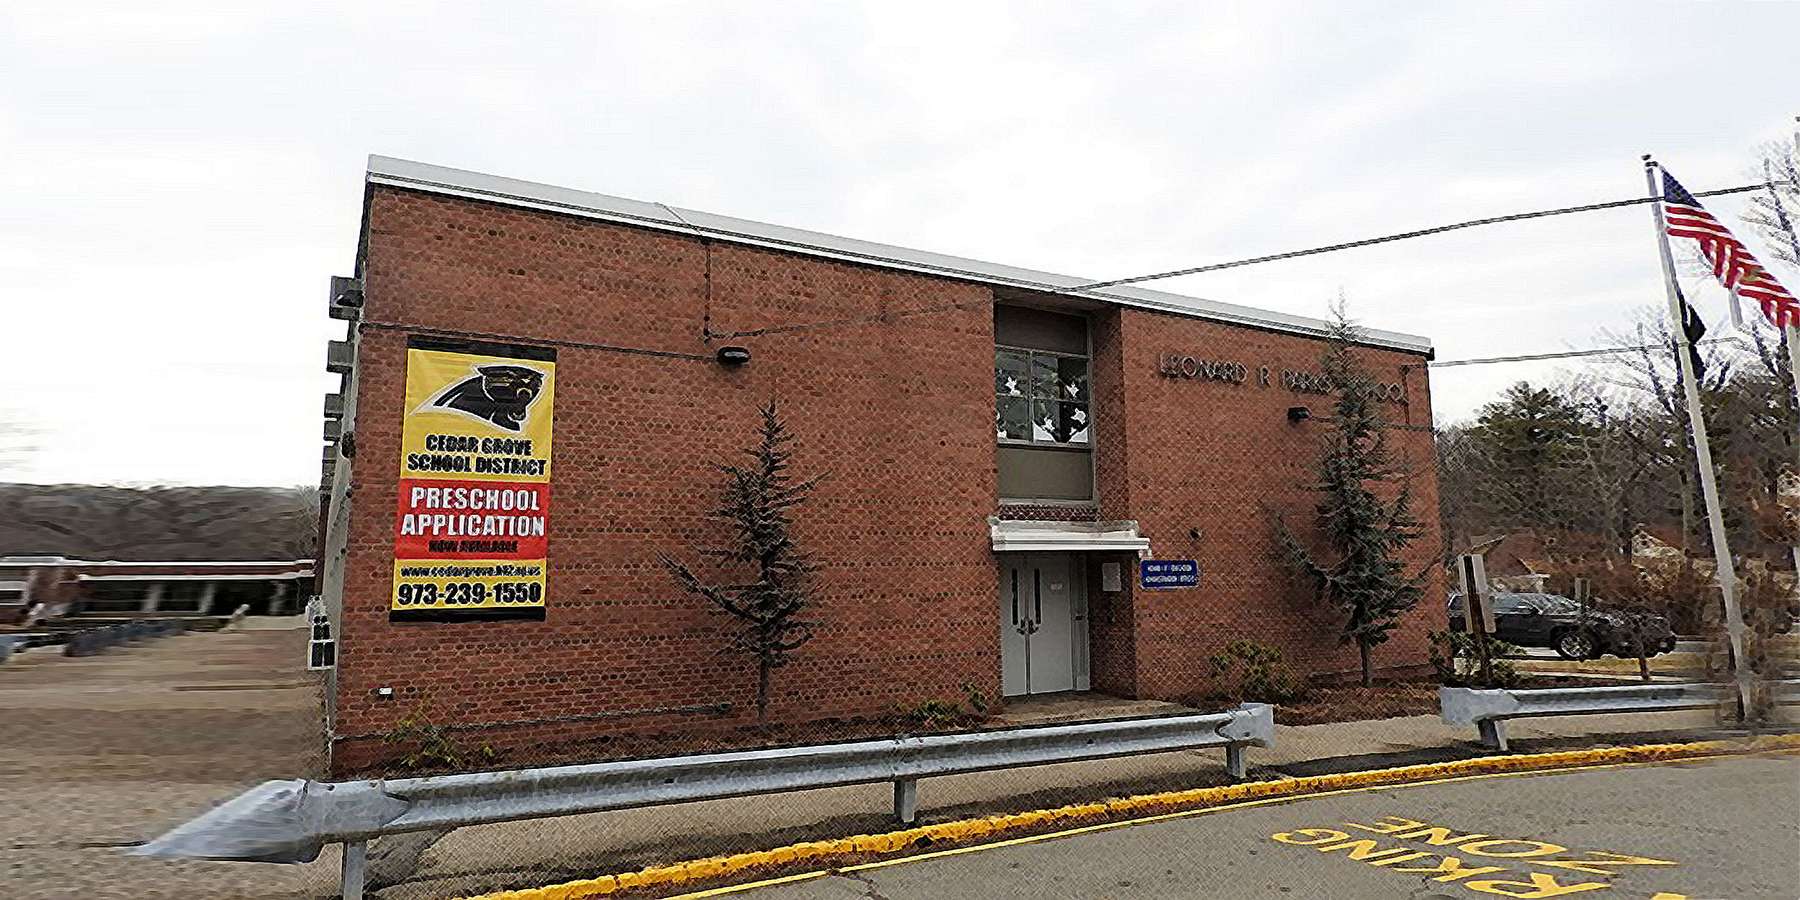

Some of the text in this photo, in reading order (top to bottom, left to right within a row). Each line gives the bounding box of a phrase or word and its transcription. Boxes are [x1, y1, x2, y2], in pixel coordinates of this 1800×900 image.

[426, 434, 532, 456] CEDAR GROVE
[407, 453, 547, 475] SCHOOL DISTRICT
[410, 487, 540, 511] PRESCHOOL
[400, 513, 545, 536] APPLICATION
[398, 582, 542, 605] 973-239-1550
[1342, 815, 1681, 876] ZONE
[1272, 828, 1690, 900] RKING
